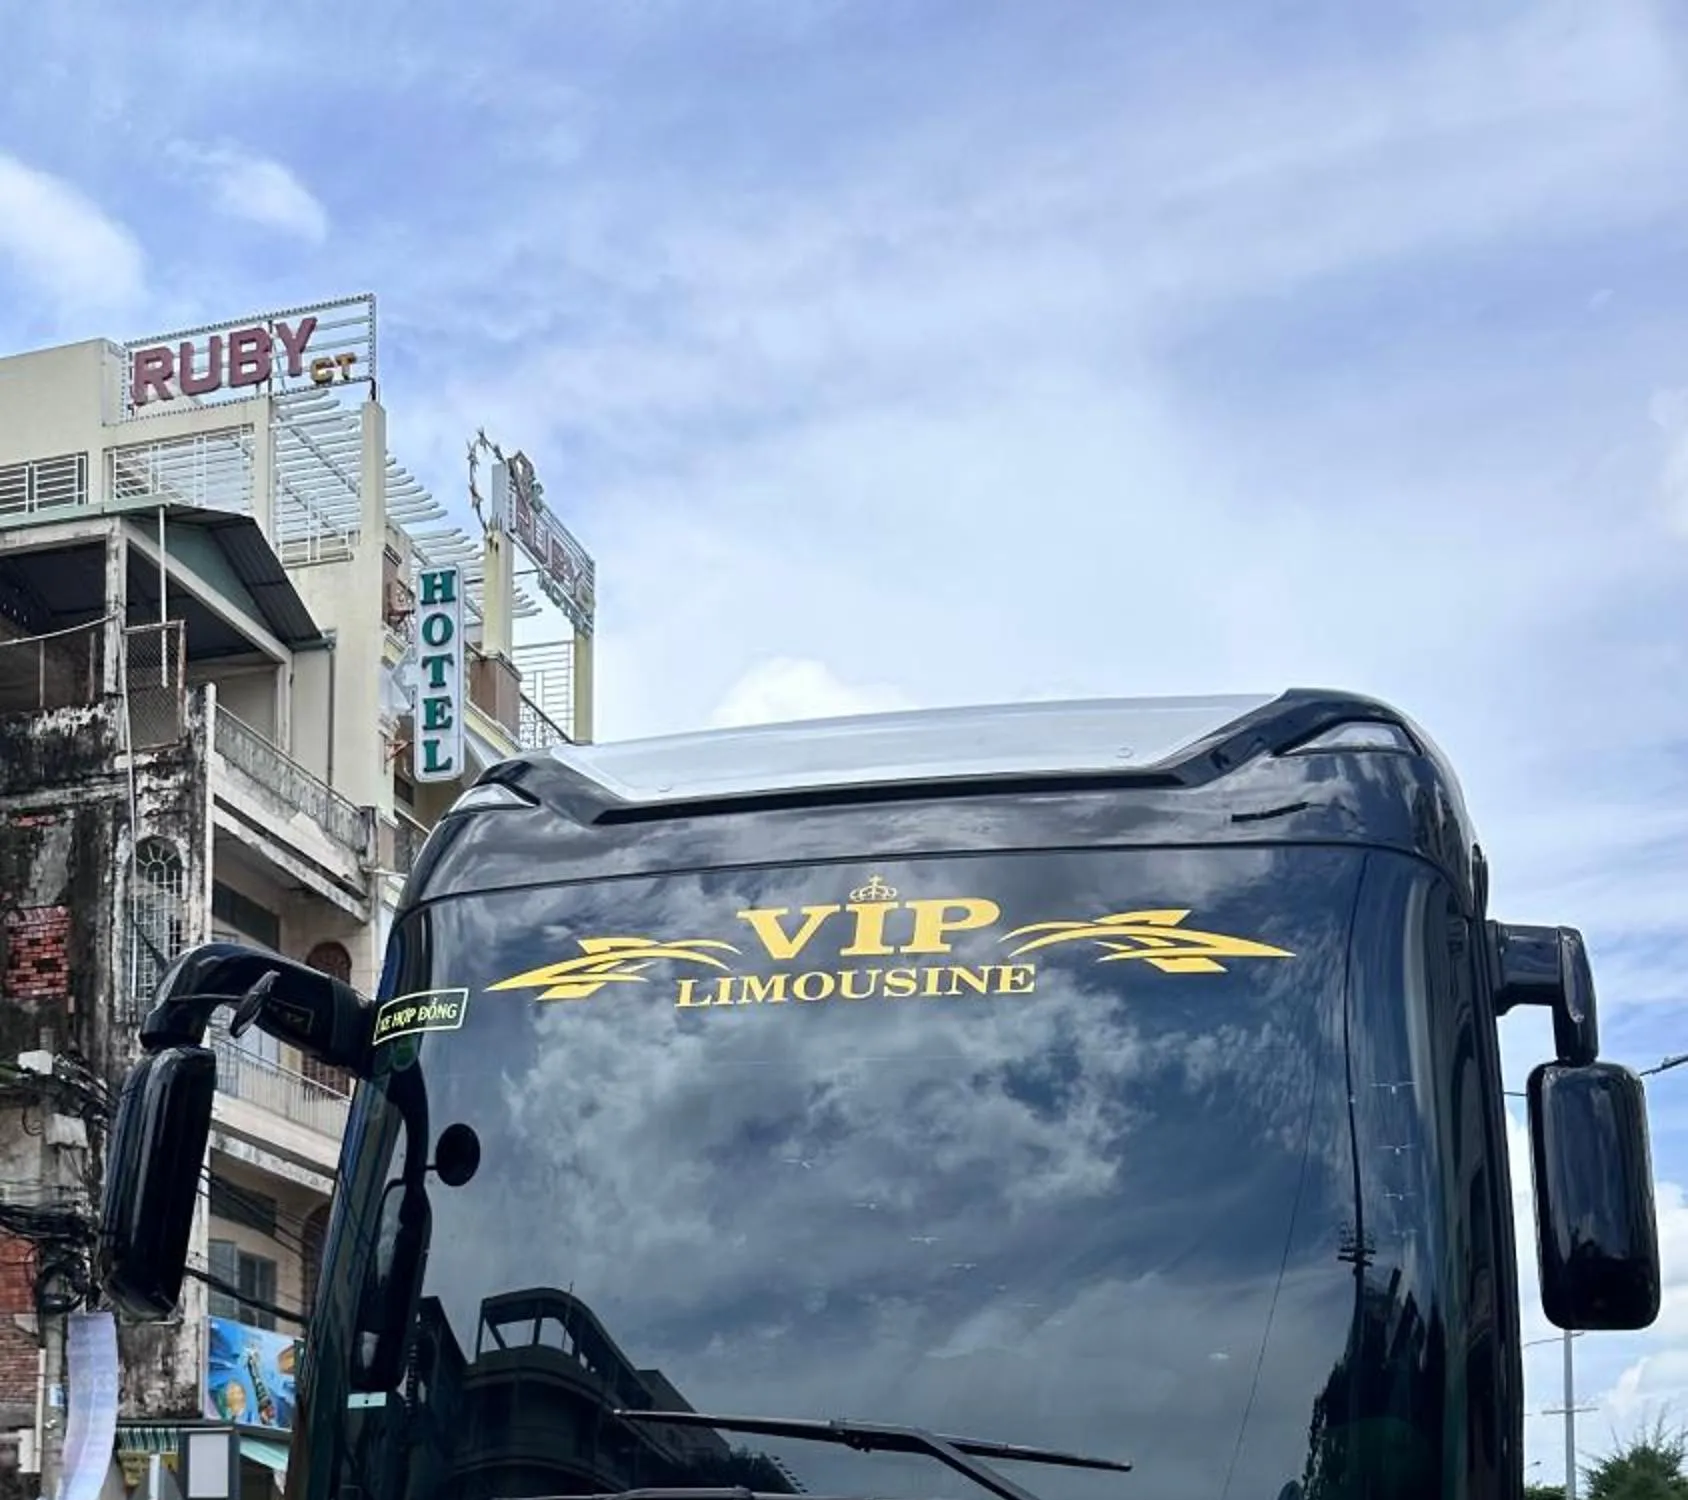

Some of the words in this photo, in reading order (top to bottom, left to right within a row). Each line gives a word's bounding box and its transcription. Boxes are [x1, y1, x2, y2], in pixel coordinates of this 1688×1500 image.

[130, 317, 318, 406] RUBY
[309, 352, 357, 384] CT
[420, 569, 457, 774] HOTEL
[736, 897, 1001, 961] VIP
[674, 962, 1036, 1009] LIMOUSINE
